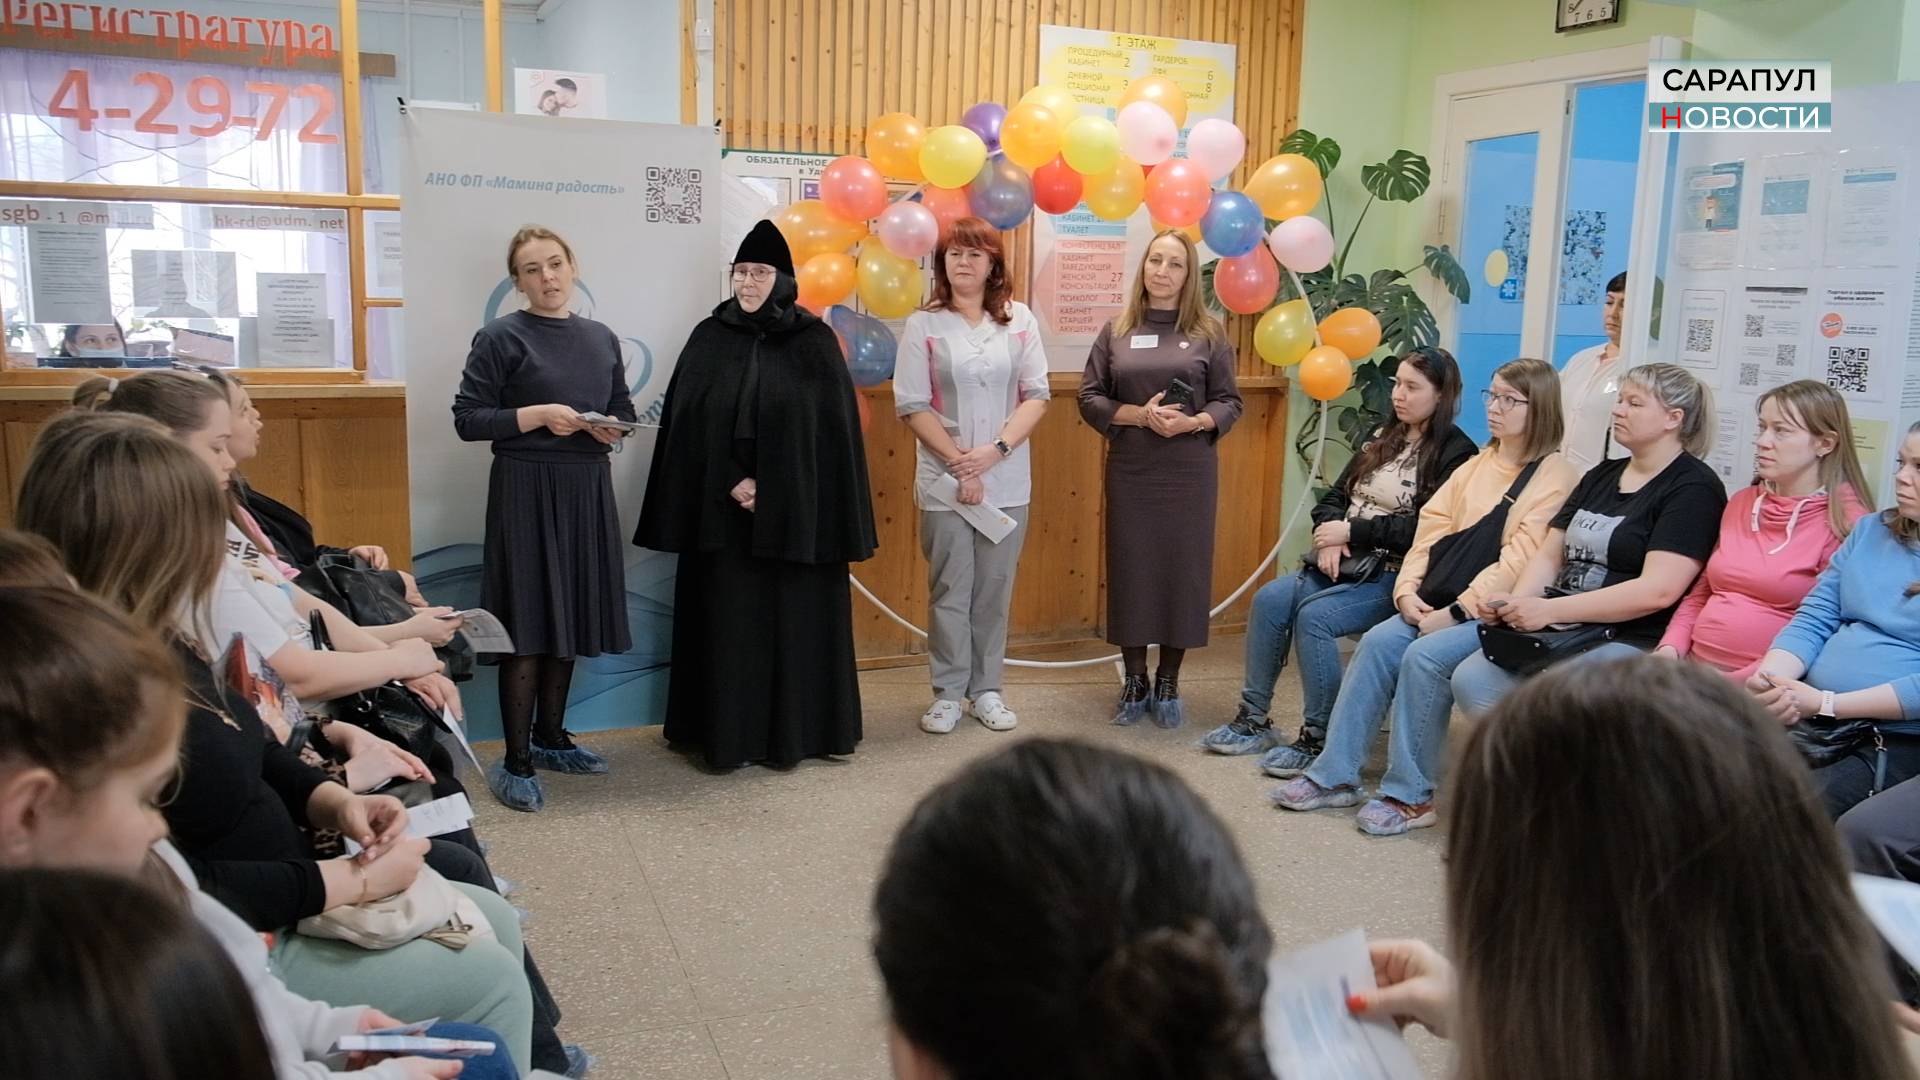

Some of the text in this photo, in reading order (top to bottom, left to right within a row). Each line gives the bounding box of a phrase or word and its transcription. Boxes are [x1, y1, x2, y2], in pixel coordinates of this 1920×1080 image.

[1575, 12, 1581, 22] 7
[1587, 9, 1593, 20] 6
[1600, 7, 1607, 18] 5
[2, 0, 337, 66] Регистратура
[1127, 37, 1157, 49] ЭТАЖ
[1123, 57, 1130, 68] 2
[1067, 72, 1103, 81] ДНЕВНОЙ
[1207, 70, 1214, 81] 6
[1205, 82, 1212, 93] 8
[49, 69, 339, 144] 4-29-72
[746, 155, 827, 167] ОБЯЗАТЕЛЬНОЕ
[425, 172, 625, 195] АНО ФП «Мамина радость»
[2, 204, 40, 225] sgb
[320, 218, 344, 229] net
[1062, 224, 1089, 234] ТУАЛЕТ
[1062, 254, 1094, 262] КАБИНЕТ
[1062, 263, 1112, 271] ЗАВЕДУЮЩЕЙ
[1061, 272, 1123, 283] ЖЕНСКОЙ 27
[1060, 282, 1117, 290] КОНСУЛЬТАЦИИ
[1060, 293, 1123, 304] ПСИХОЛОГ 28
[1060, 307, 1092, 315] КАБИНЕТ
[1059, 316, 1093, 324] СТАРШЕЙ
[1059, 325, 1098, 333] АКУШЕРКИ
